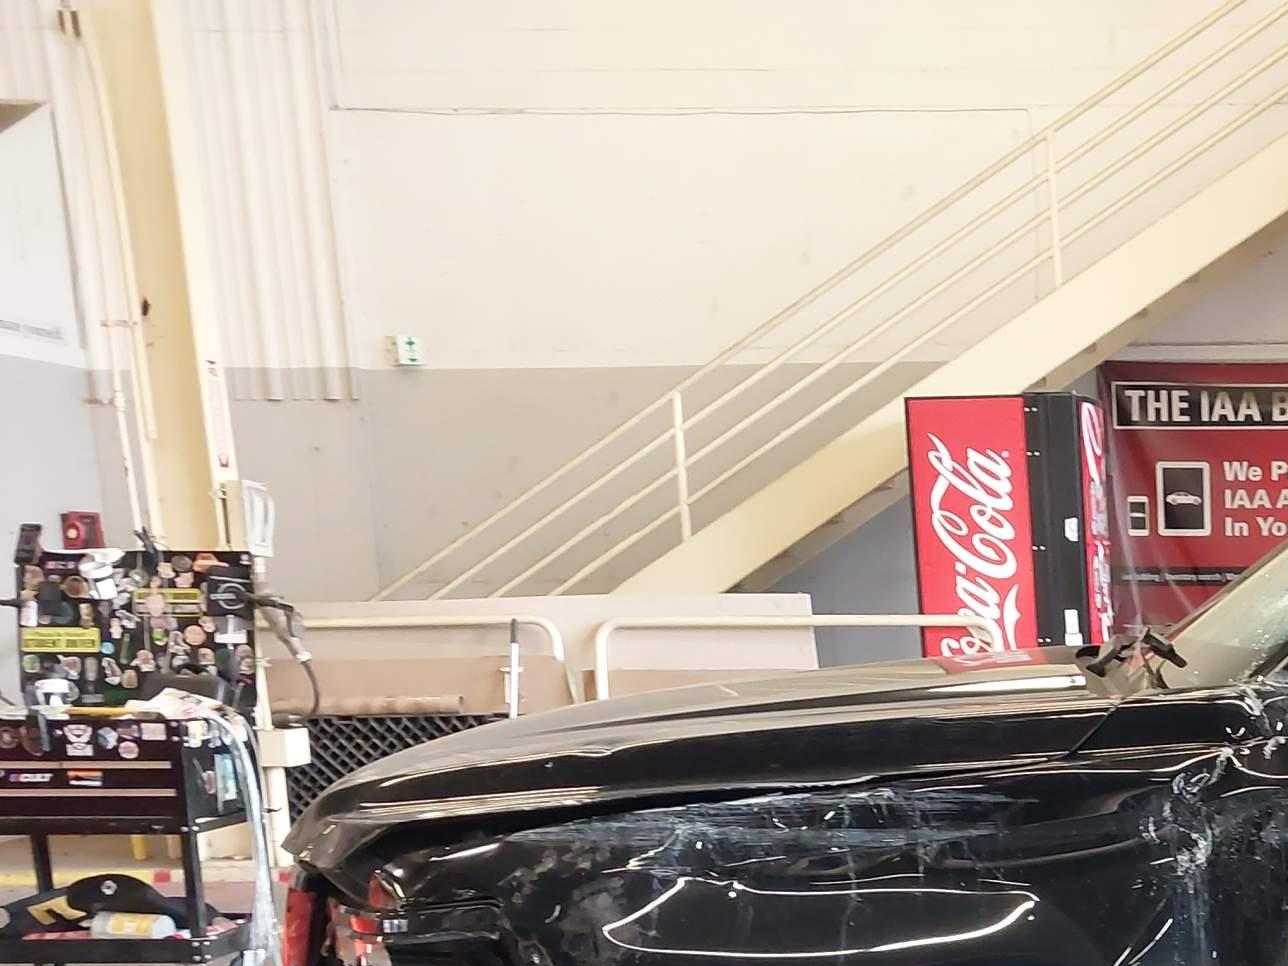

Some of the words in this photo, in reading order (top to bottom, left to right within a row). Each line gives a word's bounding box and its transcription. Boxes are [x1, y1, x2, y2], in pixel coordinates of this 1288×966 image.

[1124, 389, 1191, 422] THE
[1200, 389, 1262, 422] IAA
[1223, 461, 1262, 482] We
[1224, 489, 1272, 510] IAA
[1224, 517, 1250, 537] In
